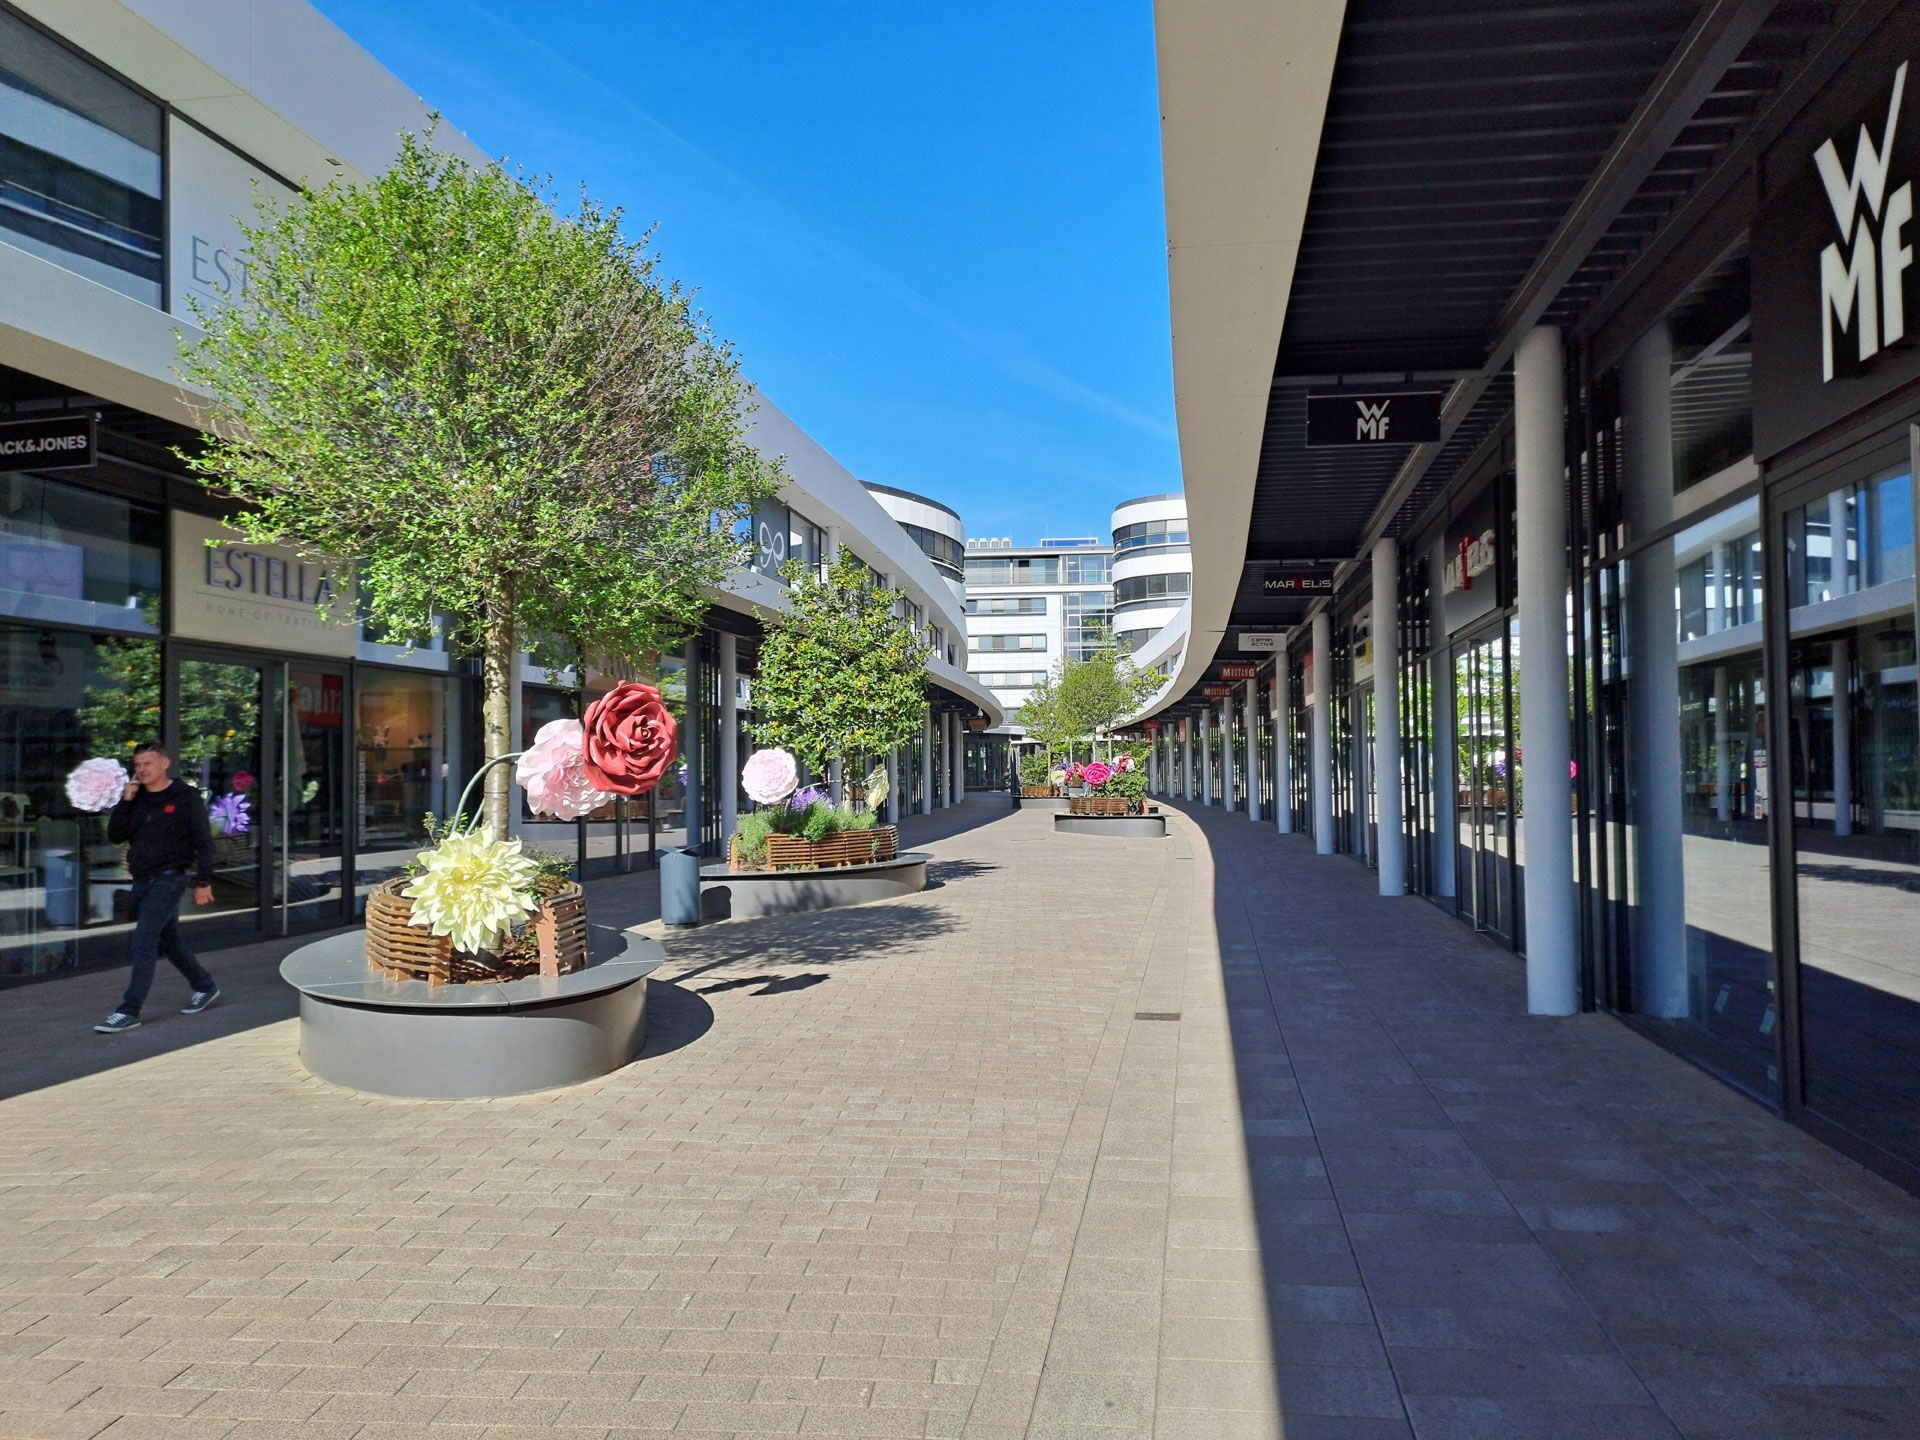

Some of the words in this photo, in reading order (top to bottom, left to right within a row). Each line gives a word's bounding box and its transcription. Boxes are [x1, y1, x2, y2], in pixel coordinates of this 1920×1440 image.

[1813, 60, 1914, 383] WMF
[192, 235, 248, 296] EST
[1356, 400, 1390, 440] WMF
[206, 545, 336, 607] ESTELLA
